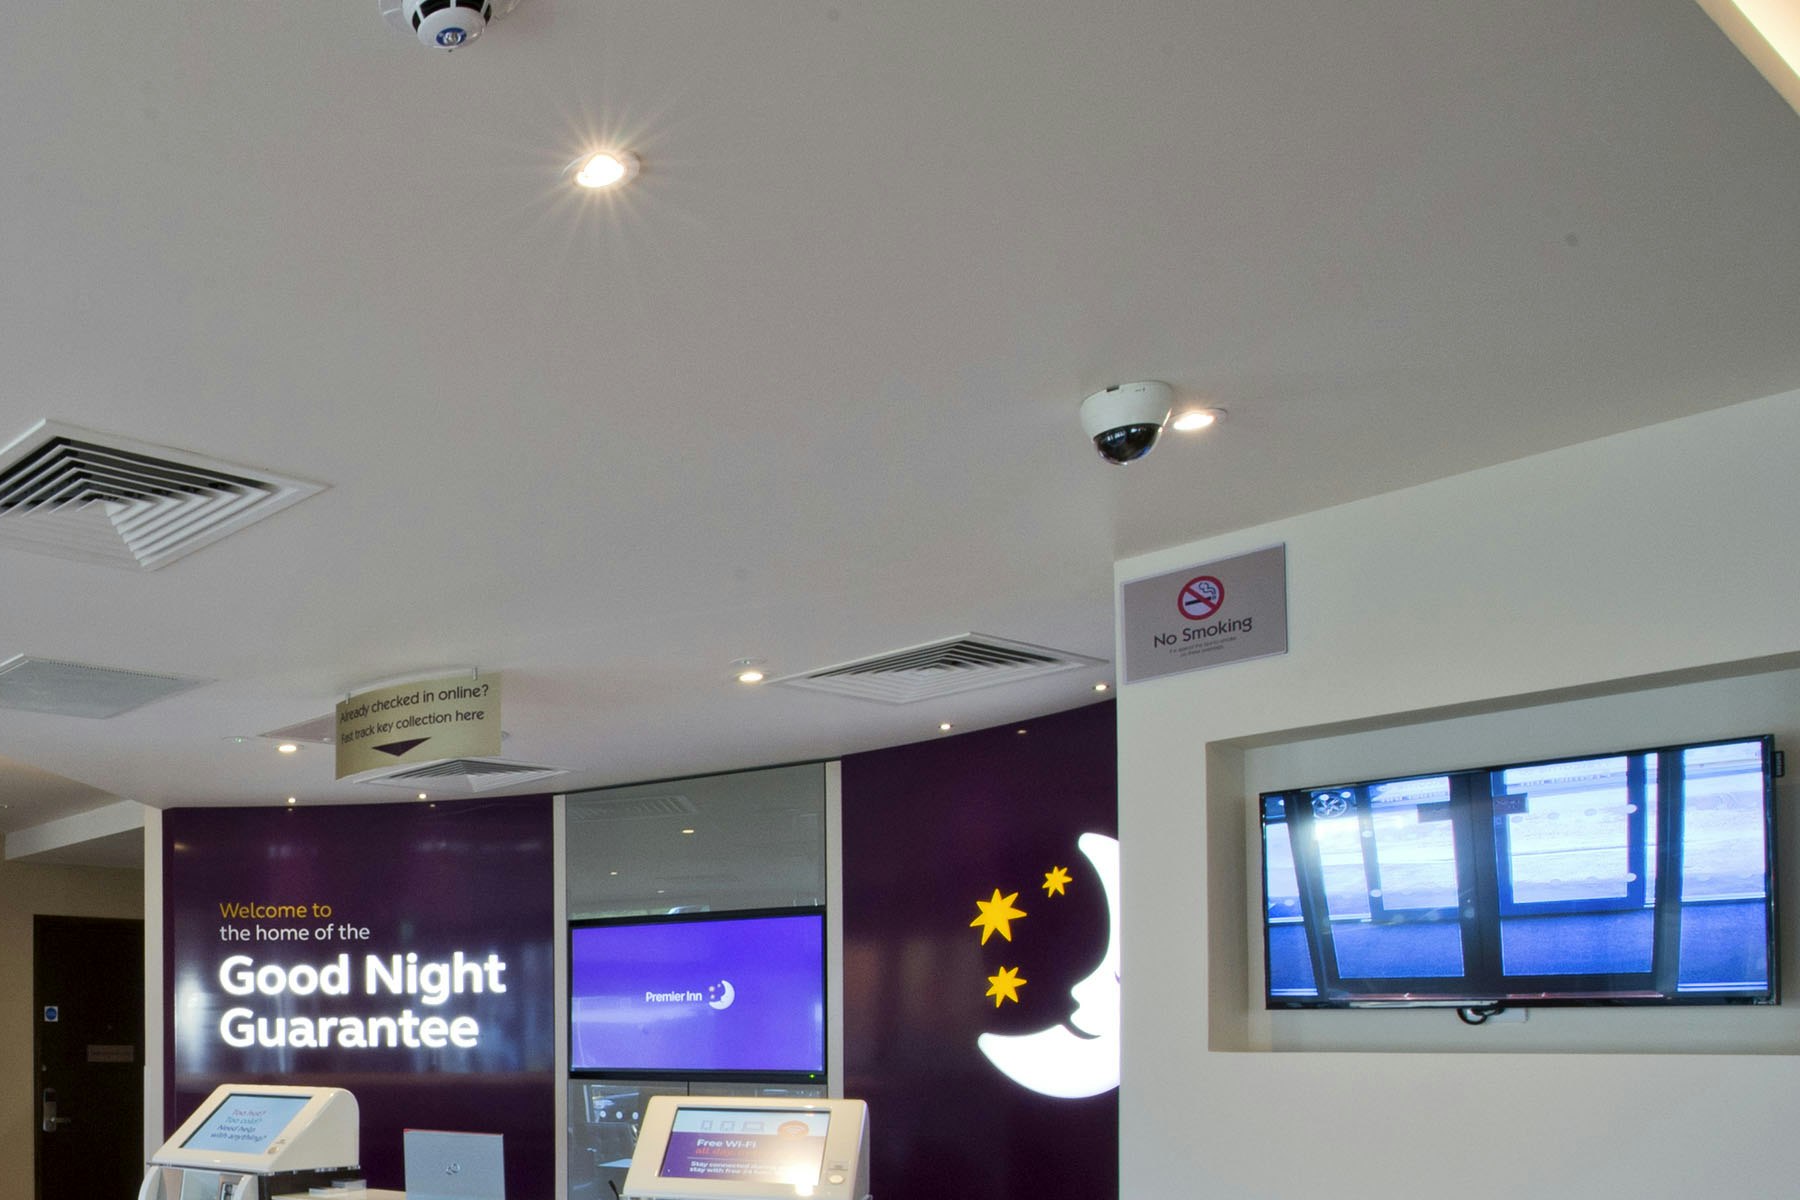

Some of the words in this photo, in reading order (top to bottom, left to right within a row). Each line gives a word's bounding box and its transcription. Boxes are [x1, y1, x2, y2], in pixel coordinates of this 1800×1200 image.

[1154, 632, 1177, 649] No
[1182, 616, 1253, 643] Smoking
[340, 703, 370, 724] Already
[371, 692, 420, 713] checked
[423, 690, 434, 703] in
[438, 684, 489, 701] online?
[341, 731, 354, 744] Fast
[355, 725, 375, 740] track
[376, 721, 394, 736] key
[396, 713, 452, 730] collection
[455, 709, 485, 722] here
[219, 902, 308, 919] Welcome
[312, 903, 332, 918] to
[219, 925, 250, 941] the
[256, 924, 310, 941] home
[314, 923, 335, 940] of
[338, 923, 371, 940] the
[219, 953, 349, 996] Good
[365, 951, 507, 1005] Night
[646, 991, 686, 1002] Premier
[686, 990, 702, 1001] Inn
[219, 1008, 479, 1048] Guarantee
[696, 1138, 724, 1148] Free
[726, 1139, 757, 1149] Wi-Fi
